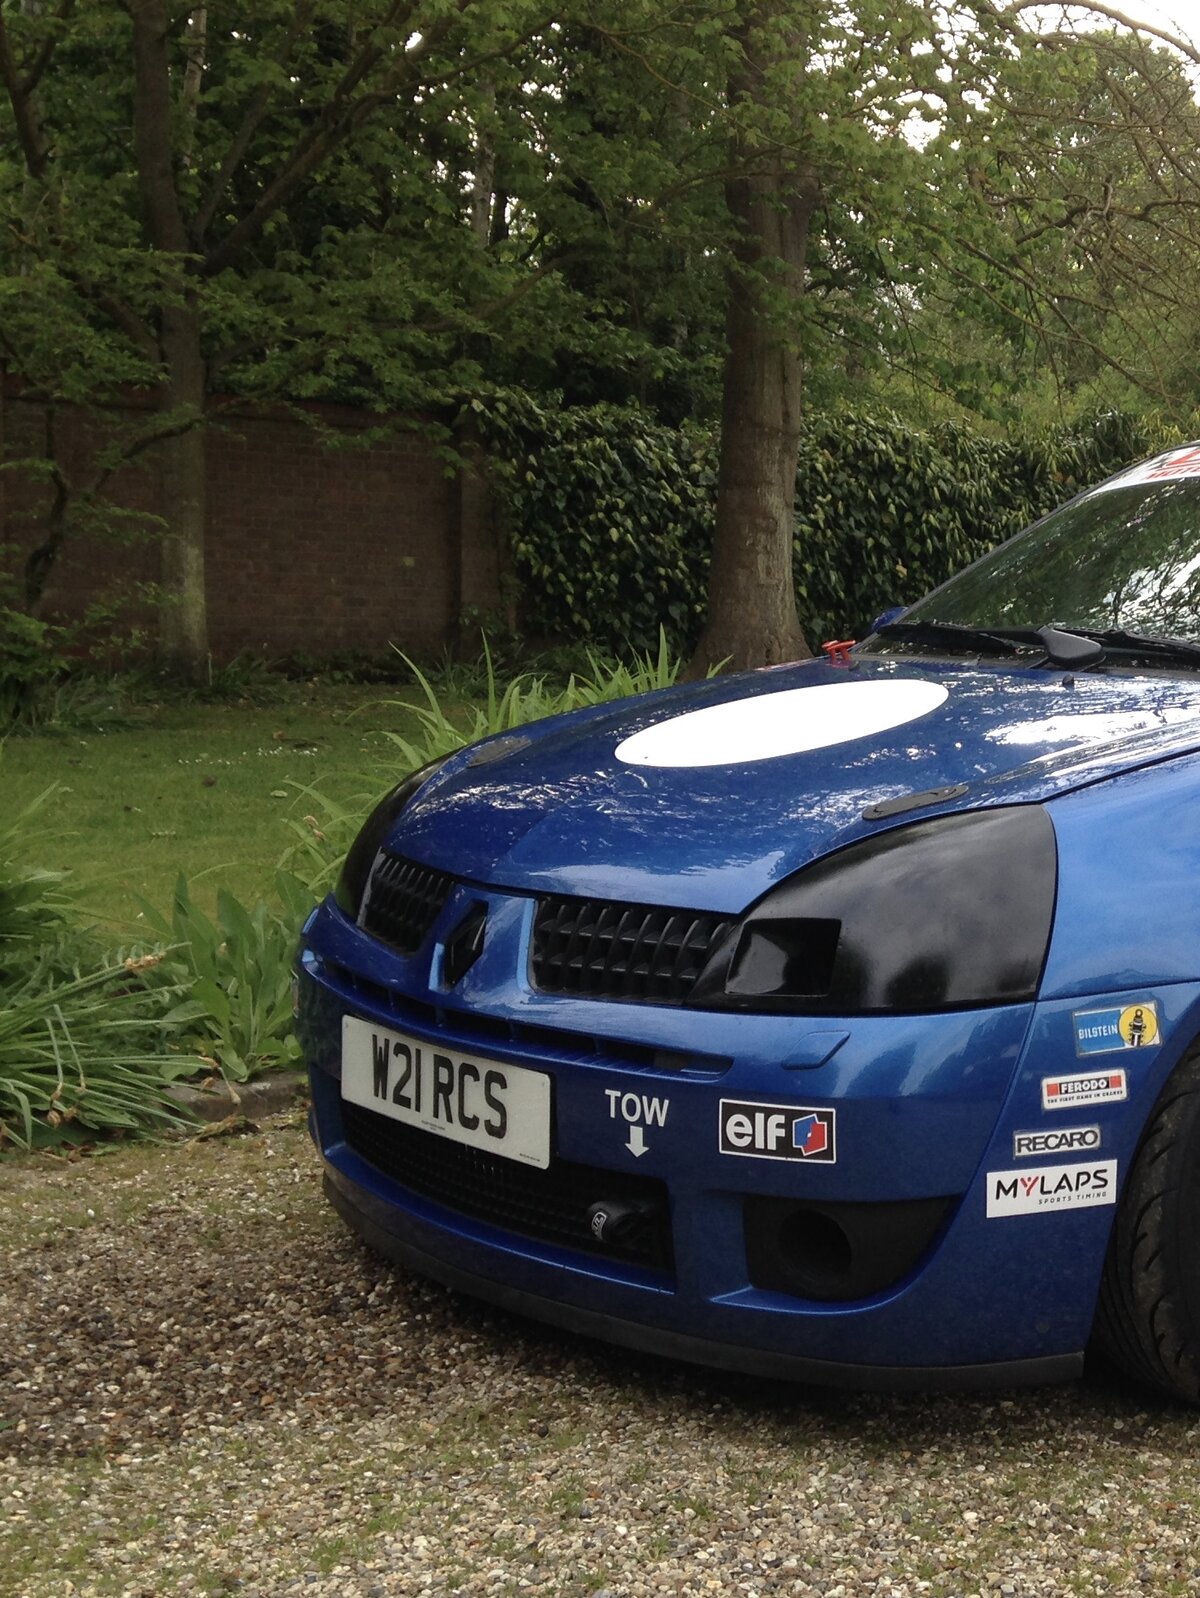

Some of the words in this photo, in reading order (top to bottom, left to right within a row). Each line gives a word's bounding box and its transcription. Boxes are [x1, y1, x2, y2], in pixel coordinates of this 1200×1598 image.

[1078, 1024, 1118, 1039] BILSTEIN
[1060, 1078, 1107, 1094] FERODO
[604, 1088, 670, 1127] TOW
[726, 1113, 786, 1150] elf
[1016, 1129, 1099, 1154] RECARO
[995, 1168, 1109, 1201] MYLAPS
[1038, 1195, 1072, 1205] SPORTS
[1076, 1191, 1107, 1200] TIMING
